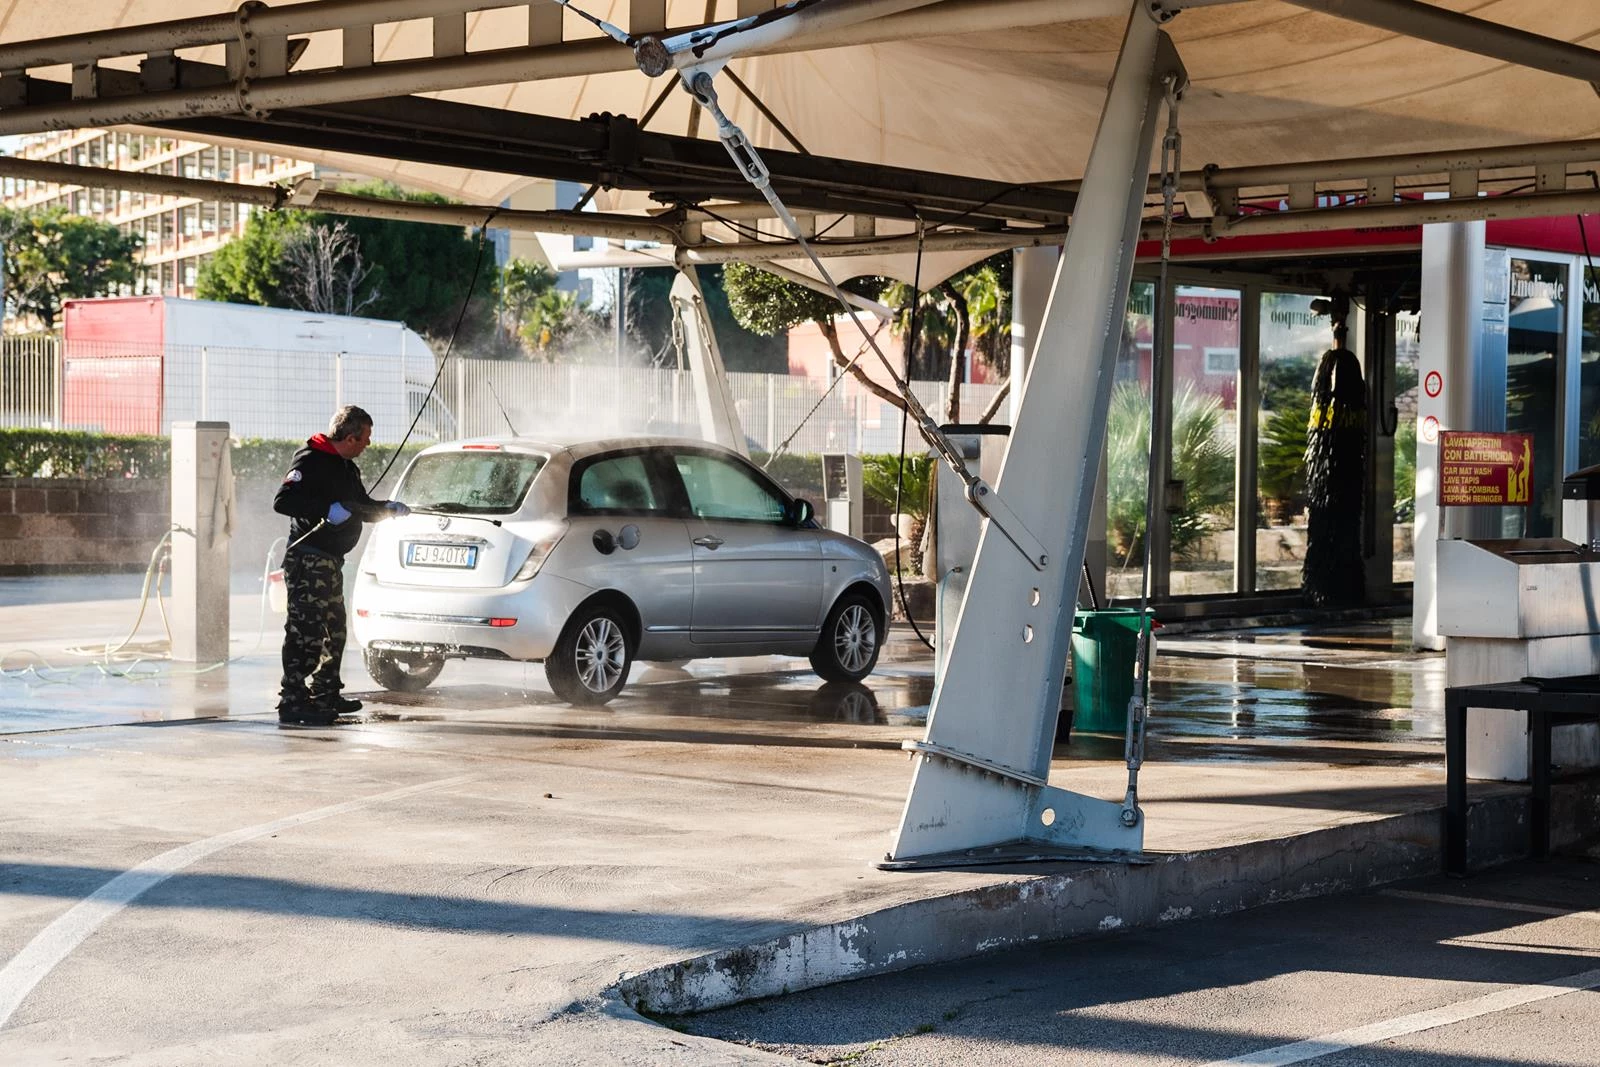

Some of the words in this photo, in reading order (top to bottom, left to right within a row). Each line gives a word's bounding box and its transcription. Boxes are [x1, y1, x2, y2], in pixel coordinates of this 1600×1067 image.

[1444, 436, 1502, 449] LAVATAPPETINI
[1444, 449, 1462, 461] CON
[1464, 450, 1513, 462] BATTERICIDA
[1443, 466, 1458, 475] CAR
[1459, 466, 1473, 475] MAT
[1474, 467, 1493, 476] WASH
[1443, 476, 1460, 484] LAVE
[1461, 476, 1480, 485] TAPIS
[1443, 485, 1459, 494] LAVA
[1461, 485, 1500, 494] ALFOMBRAS
[1443, 494, 1472, 503] TEPPICH
[1473, 494, 1503, 503] REINIGER
